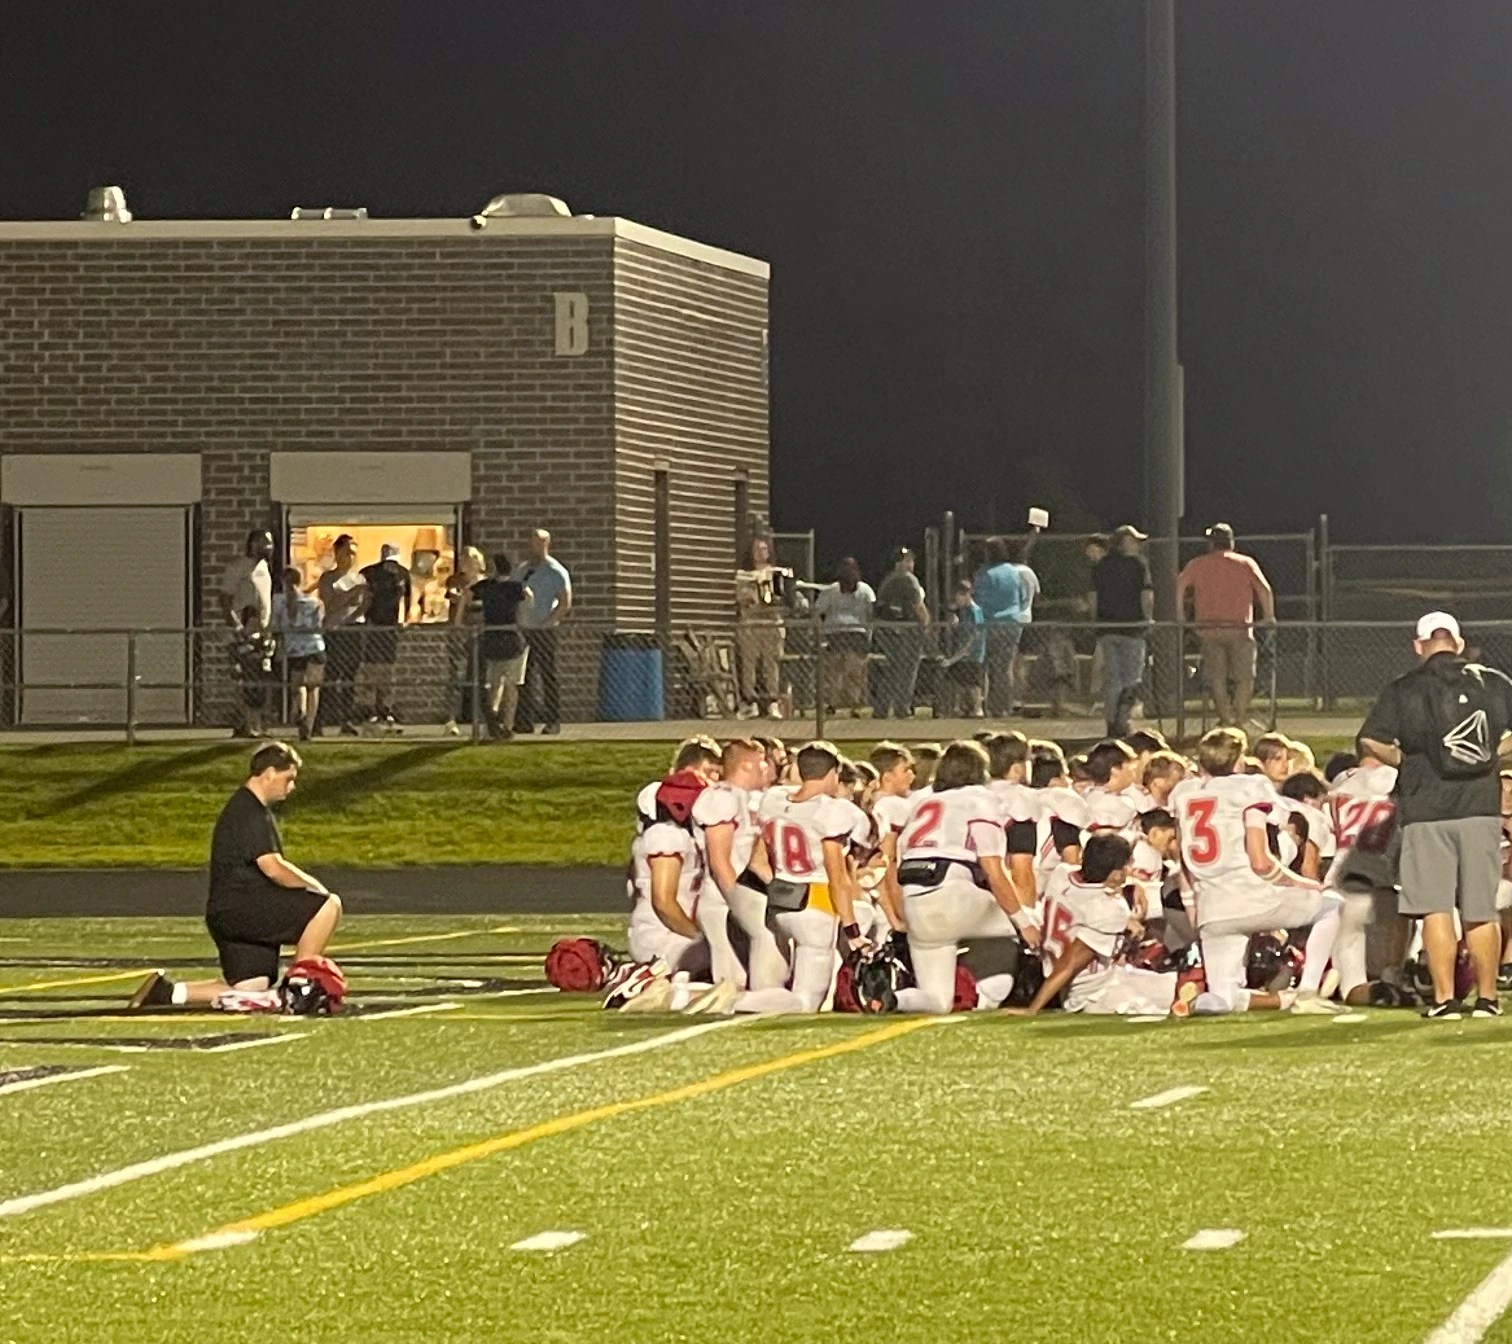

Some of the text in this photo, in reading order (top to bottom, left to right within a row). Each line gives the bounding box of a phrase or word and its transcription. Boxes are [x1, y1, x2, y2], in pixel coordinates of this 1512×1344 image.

[553, 292, 589, 356] B
[907, 800, 944, 849] 2
[1186, 797, 1221, 866] 3
